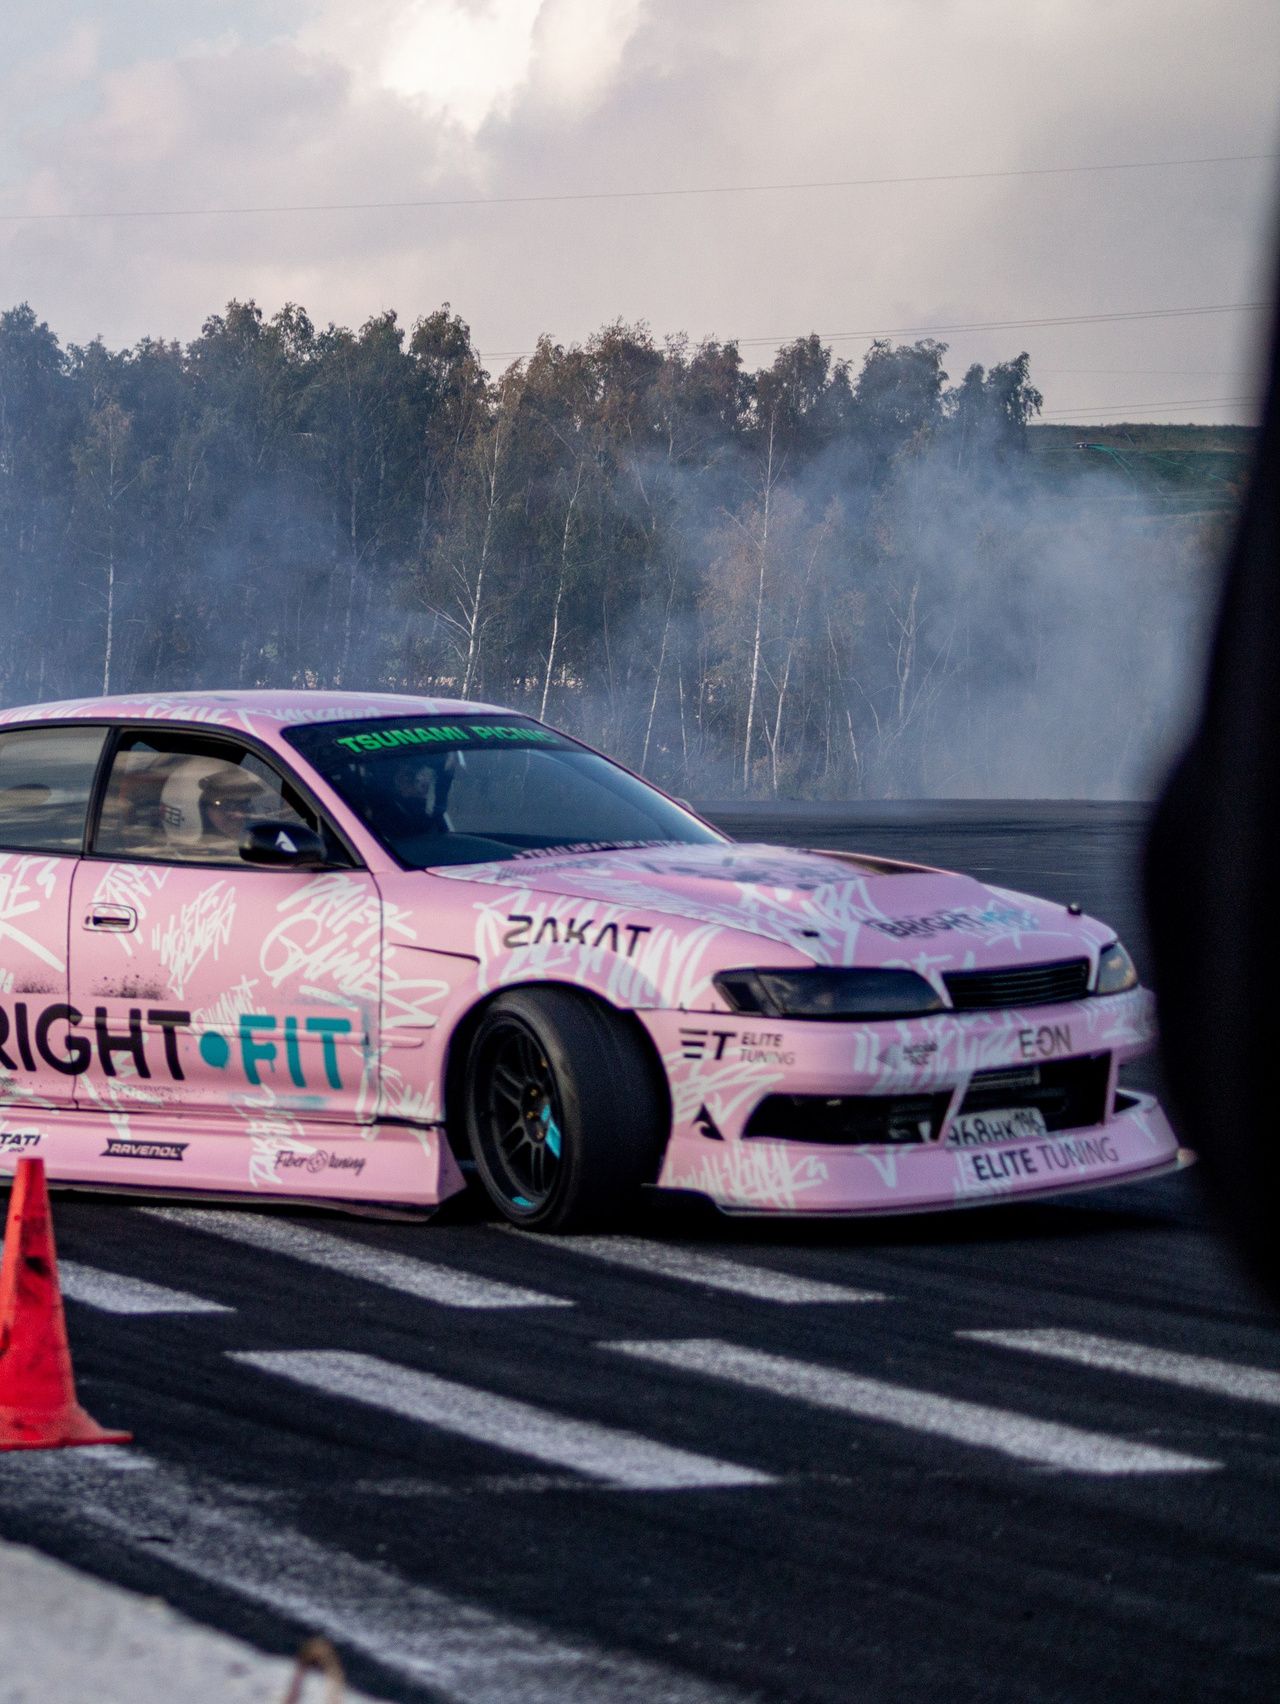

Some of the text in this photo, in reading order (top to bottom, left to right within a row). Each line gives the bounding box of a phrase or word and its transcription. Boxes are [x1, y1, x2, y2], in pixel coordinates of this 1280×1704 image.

[337, 725, 558, 753] TSUNAMI PICNIC
[741, 1032, 782, 1047] ELITE
[238, 1013, 352, 1090] FIT
[740, 1048, 795, 1066] TUNNG
[110, 1143, 178, 1158] RAVENOL
[971, 1137, 1119, 1181] ELITE TUNING
